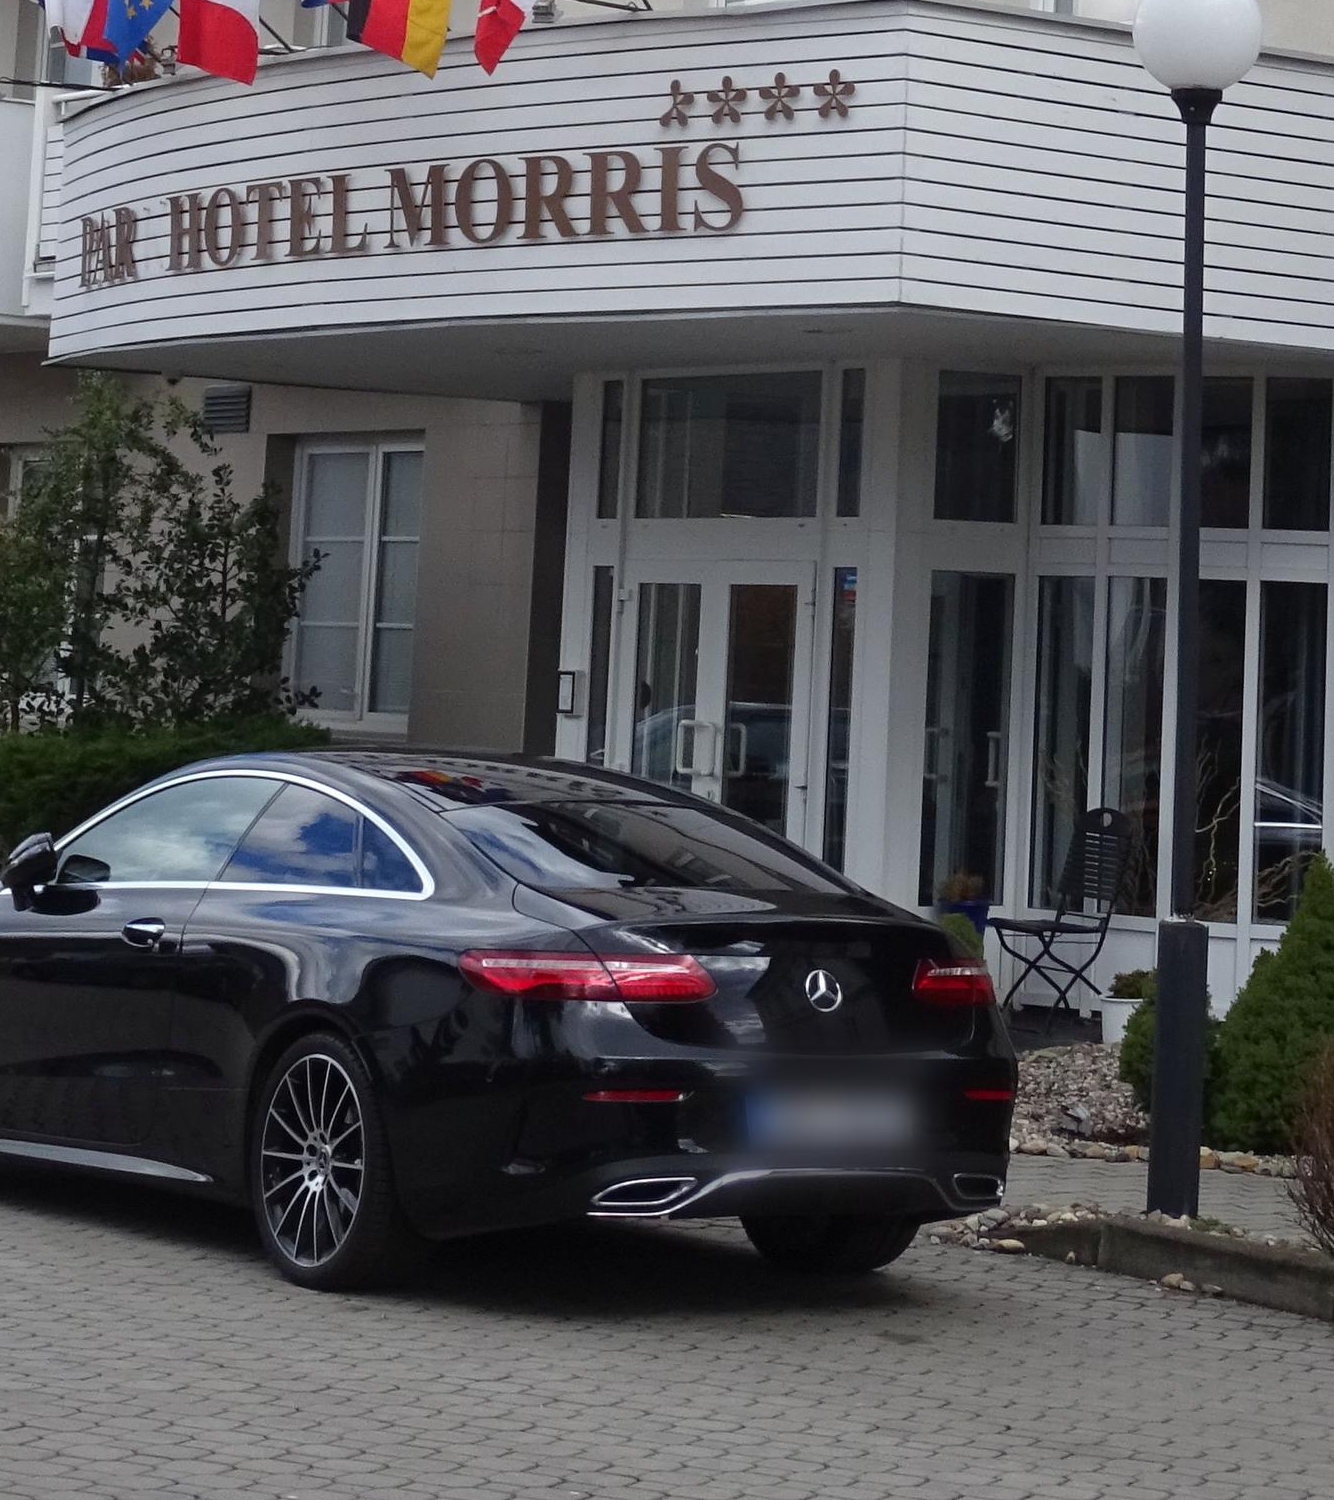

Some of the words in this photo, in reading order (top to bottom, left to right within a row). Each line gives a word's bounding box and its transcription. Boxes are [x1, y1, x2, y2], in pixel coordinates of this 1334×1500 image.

[79, 206, 137, 288] PAR
[165, 174, 367, 271] HOTEL
[384, 141, 743, 249] MORRIS
